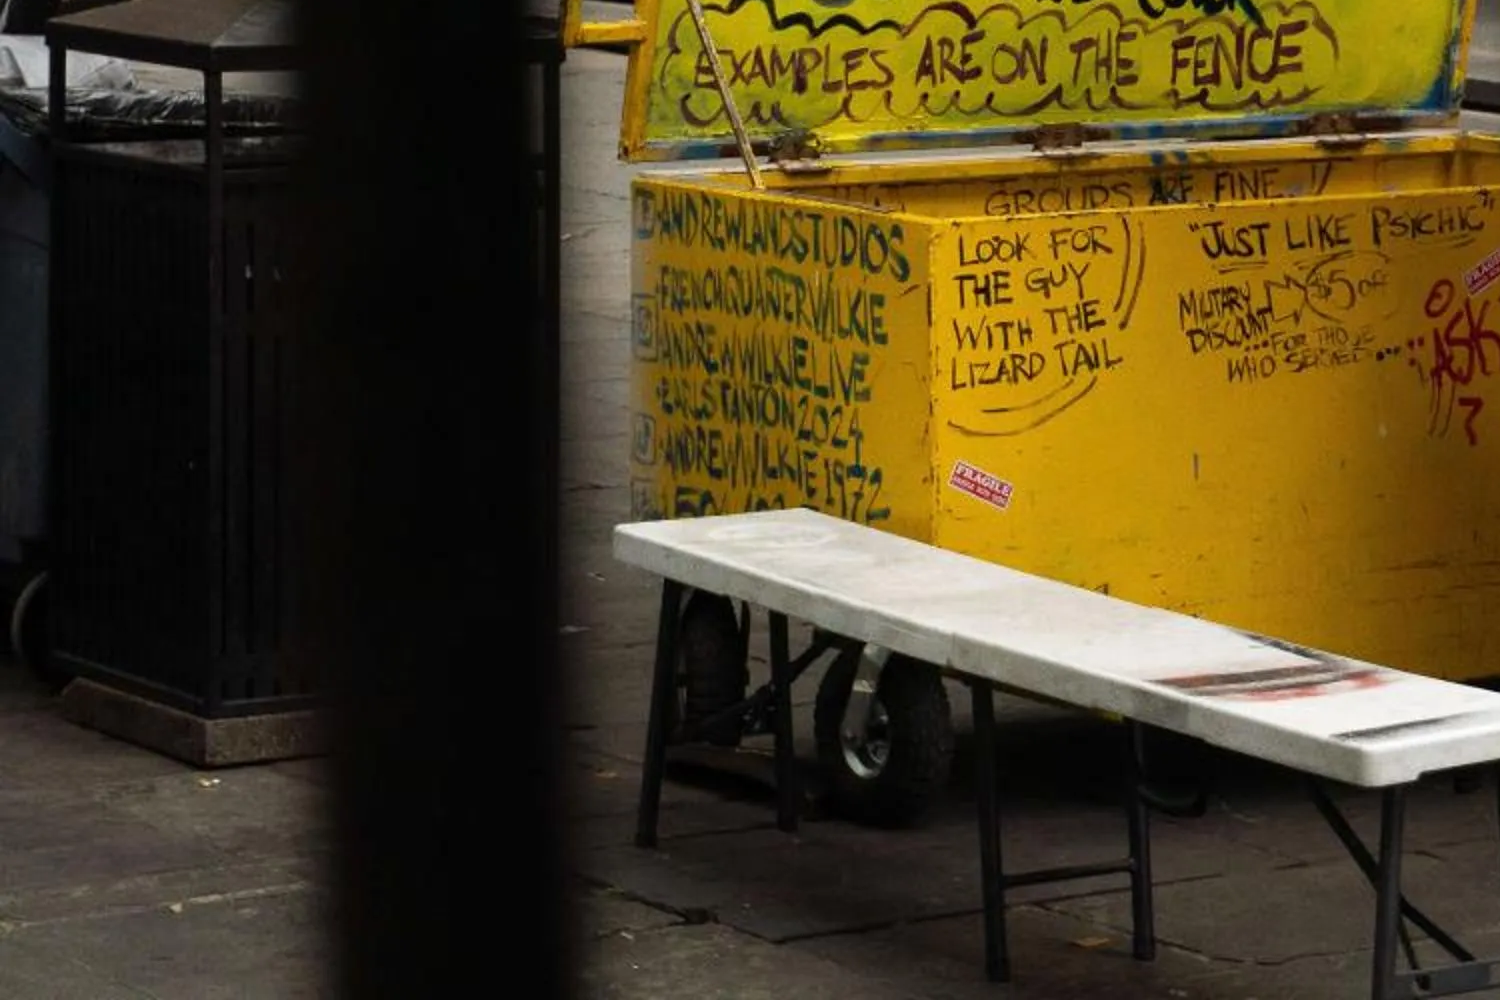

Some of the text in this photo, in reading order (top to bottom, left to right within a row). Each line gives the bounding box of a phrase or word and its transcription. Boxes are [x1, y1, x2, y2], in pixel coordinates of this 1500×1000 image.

[694, 20, 1308, 94] EXAMPLES ARE ON THE FENCE
[985, 182, 1134, 216] GROUPS
[959, 226, 1113, 266] LOOK FOR
[1285, 214, 1355, 251] LIKE
[953, 262, 1090, 308] THE GUY
[953, 299, 1106, 350] WITH THE
[951, 338, 1124, 390] LIZARD TAIL
